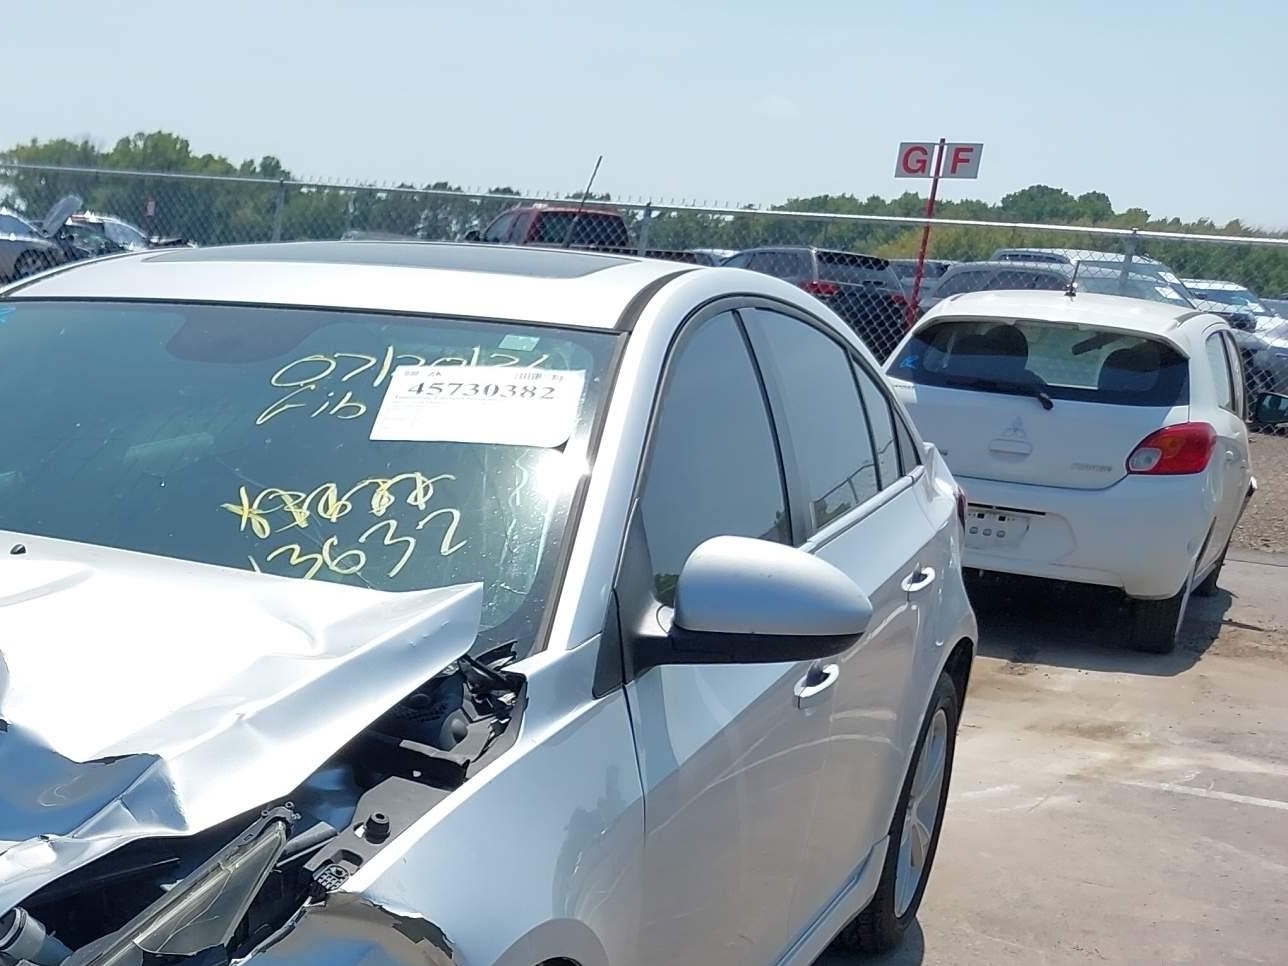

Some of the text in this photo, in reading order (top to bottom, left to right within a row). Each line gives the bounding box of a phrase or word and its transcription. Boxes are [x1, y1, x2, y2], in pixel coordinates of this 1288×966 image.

[902, 146, 929, 174] G
[950, 147, 974, 174] F
[408, 382, 556, 400] 45730382
